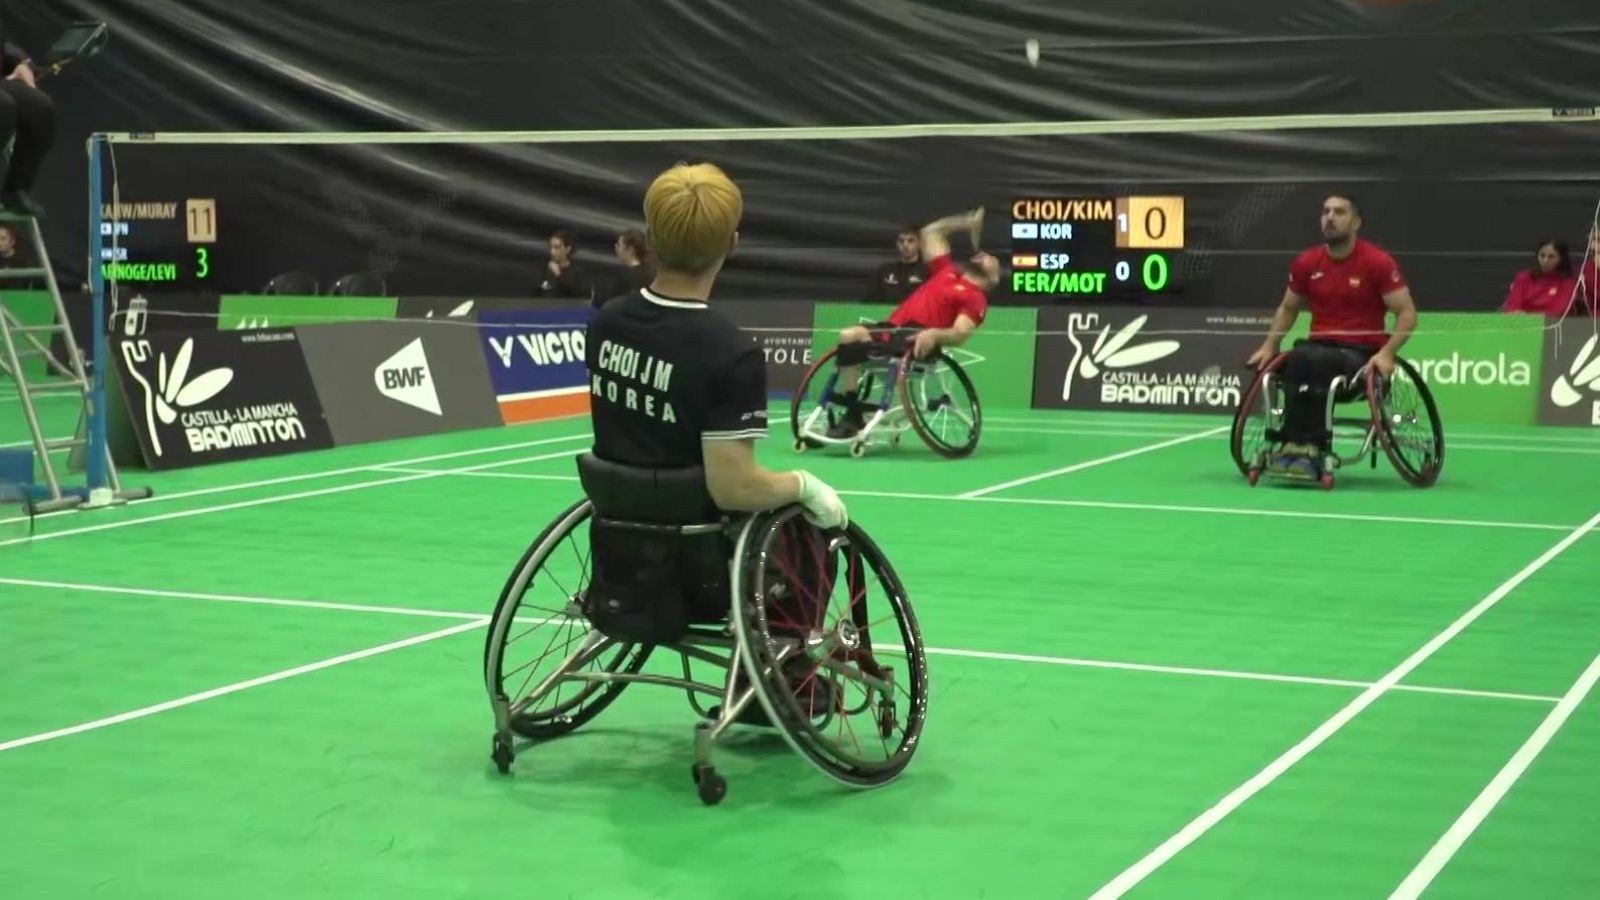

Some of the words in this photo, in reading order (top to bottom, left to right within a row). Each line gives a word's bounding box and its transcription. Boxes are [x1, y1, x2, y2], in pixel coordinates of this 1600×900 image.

[189, 207, 212, 235] 11
[1012, 200, 1113, 221] CHOI/KIM
[1118, 213, 1127, 232] 1
[1145, 206, 1166, 240] 0
[1040, 223, 1072, 240] KOR
[196, 247, 208, 277] 3
[1040, 253, 1070, 270] ESP
[1115, 260, 1130, 281] 0
[1143, 253, 1168, 291] 0
[1012, 272, 1106, 293] FER/MOT
[516, 329, 588, 366] VICTO
[598, 340, 641, 379] CHOI
[383, 366, 426, 390] BWF
[1102, 371, 1159, 386] CASTILLA
[1167, 372, 1184, 386] LA
[1185, 373, 1241, 388] MANCHA
[592, 373, 677, 424] KOREA
[181, 411, 233, 427] CASTILLA
[237, 407, 253, 421] LA
[253, 402, 297, 420] MANCHA
[185, 417, 306, 453] BADMINTON
